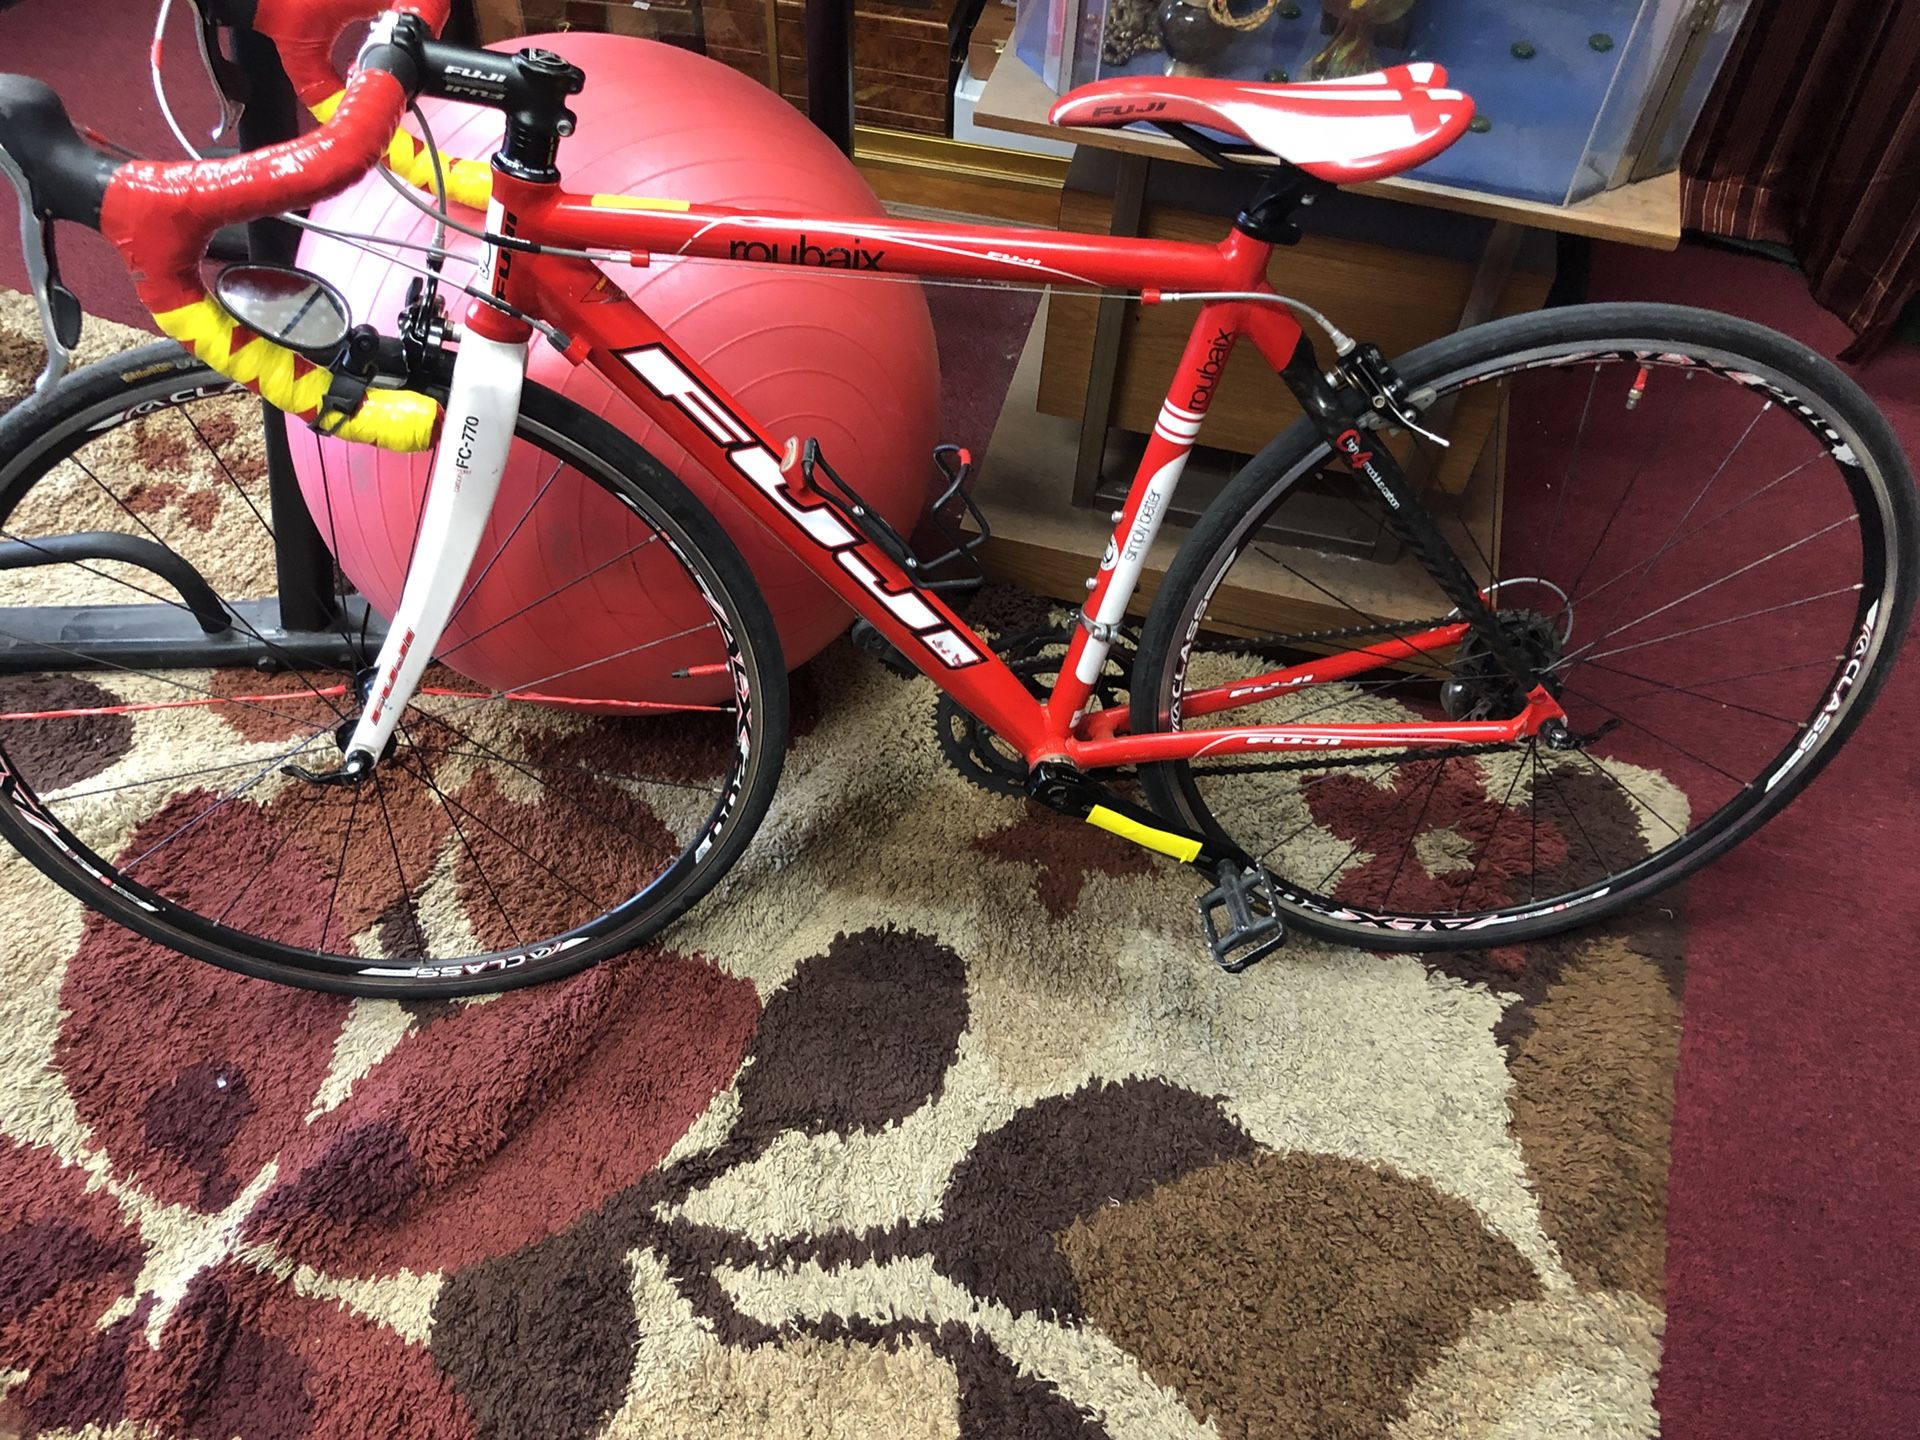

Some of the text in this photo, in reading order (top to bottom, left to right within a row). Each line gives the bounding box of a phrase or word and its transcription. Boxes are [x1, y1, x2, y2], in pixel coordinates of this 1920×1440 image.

[444, 65, 507, 82] FUJI
[1092, 101, 1167, 117] FUJI
[729, 234, 885, 271] roubaix
[1188, 328, 1233, 412] roubaix
[455, 415, 479, 469] FC-770
[611, 342, 988, 669] FUJI
[1136, 488, 1162, 525] better
[370, 627, 415, 726] FUJI
[1228, 673, 1314, 699] FUJI
[1246, 736, 1342, 746] FUJI
